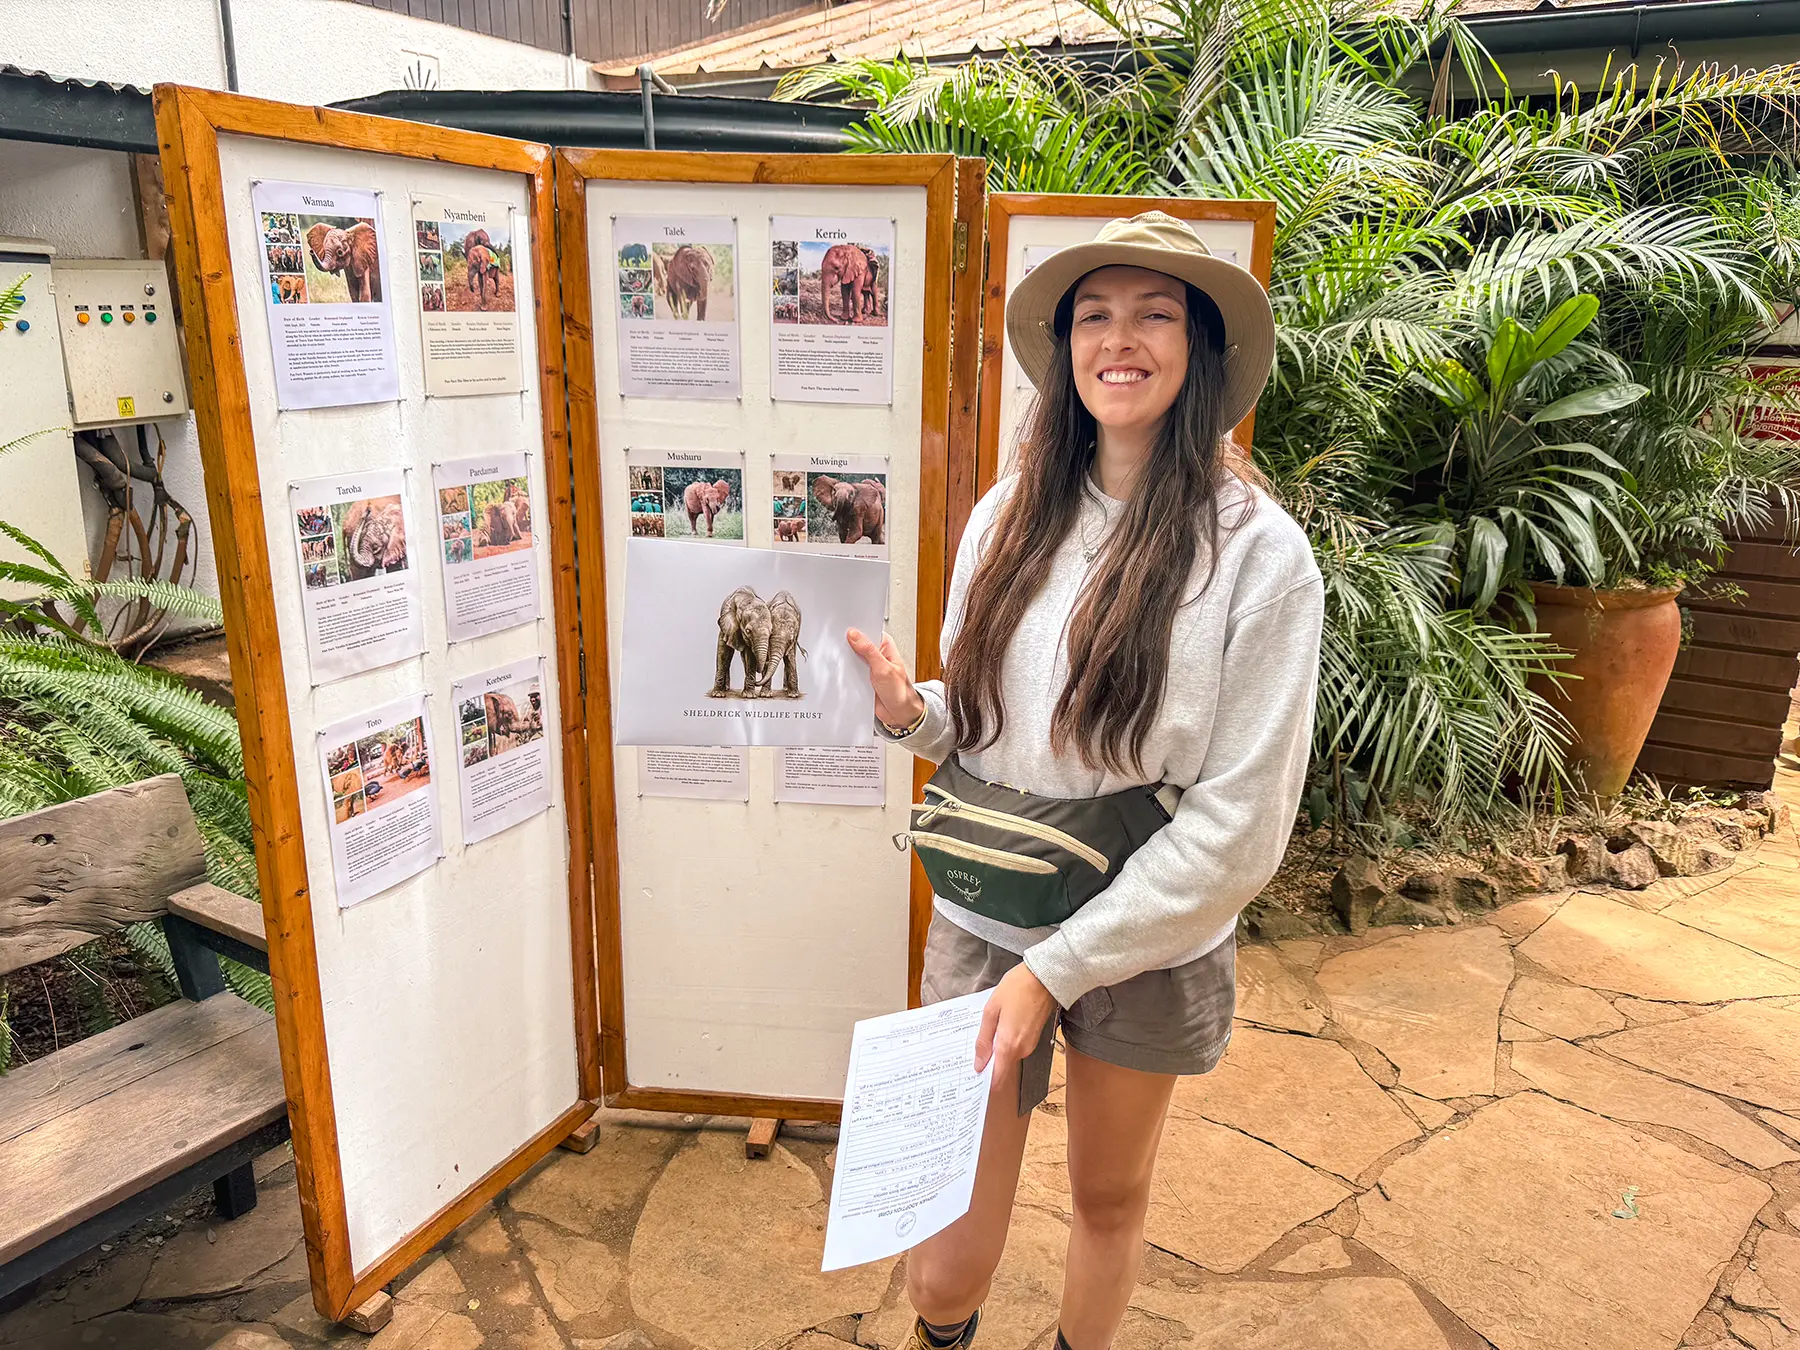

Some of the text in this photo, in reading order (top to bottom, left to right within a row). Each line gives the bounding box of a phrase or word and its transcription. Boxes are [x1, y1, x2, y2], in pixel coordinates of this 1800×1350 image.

[302, 195, 335, 208] Wamata
[444, 208, 486, 223] Nyambeni
[663, 226, 686, 236] Talek
[815, 228, 847, 240] Kerrio
[667, 452, 702, 462] Mushuru
[810, 457, 848, 468] Muwingu
[469, 466, 499, 478] Pardamat
[336, 484, 362, 496] Taroha
[683, 709, 823, 720] SHELDRICK WILDLIFE TRUST
[366, 718, 383, 730] Toto
[946, 869, 981, 886] OSPREY
